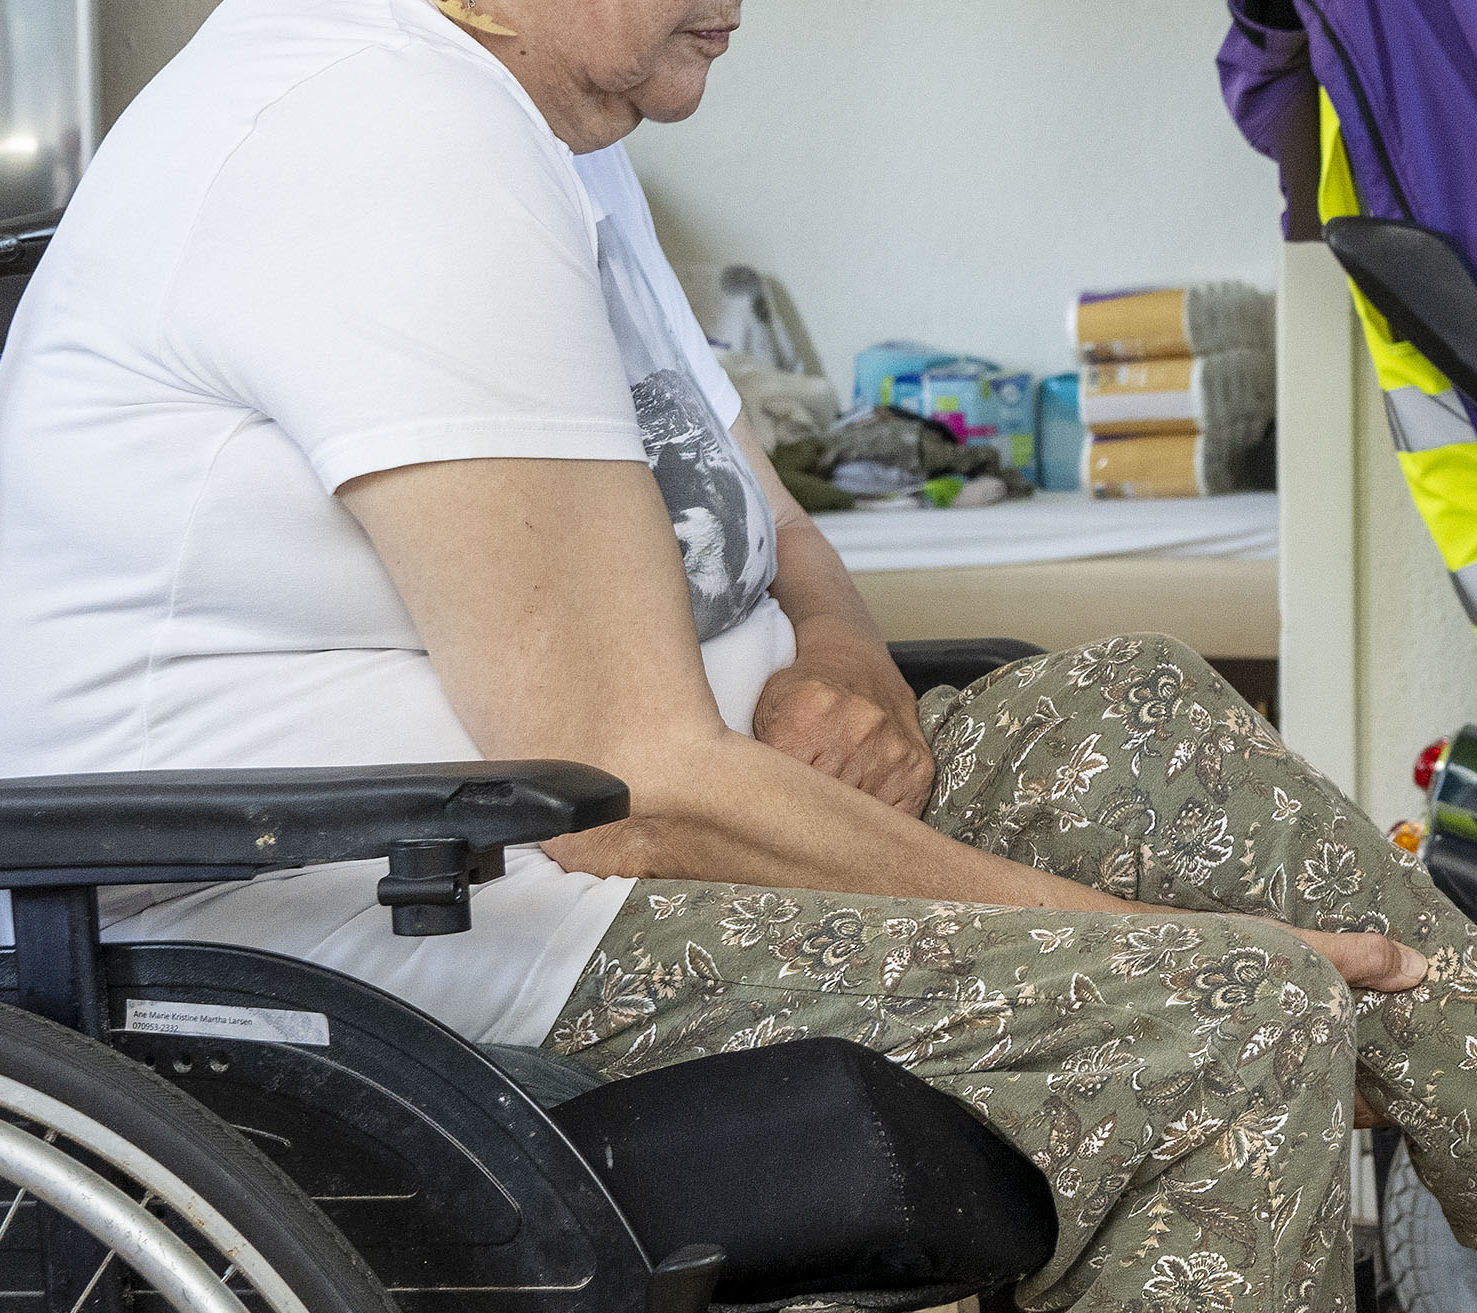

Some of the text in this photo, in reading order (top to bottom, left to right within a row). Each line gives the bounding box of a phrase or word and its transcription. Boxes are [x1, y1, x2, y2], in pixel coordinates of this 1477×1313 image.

[133, 1010, 253, 1026] Ane Marie Kristine Martha Larsen
